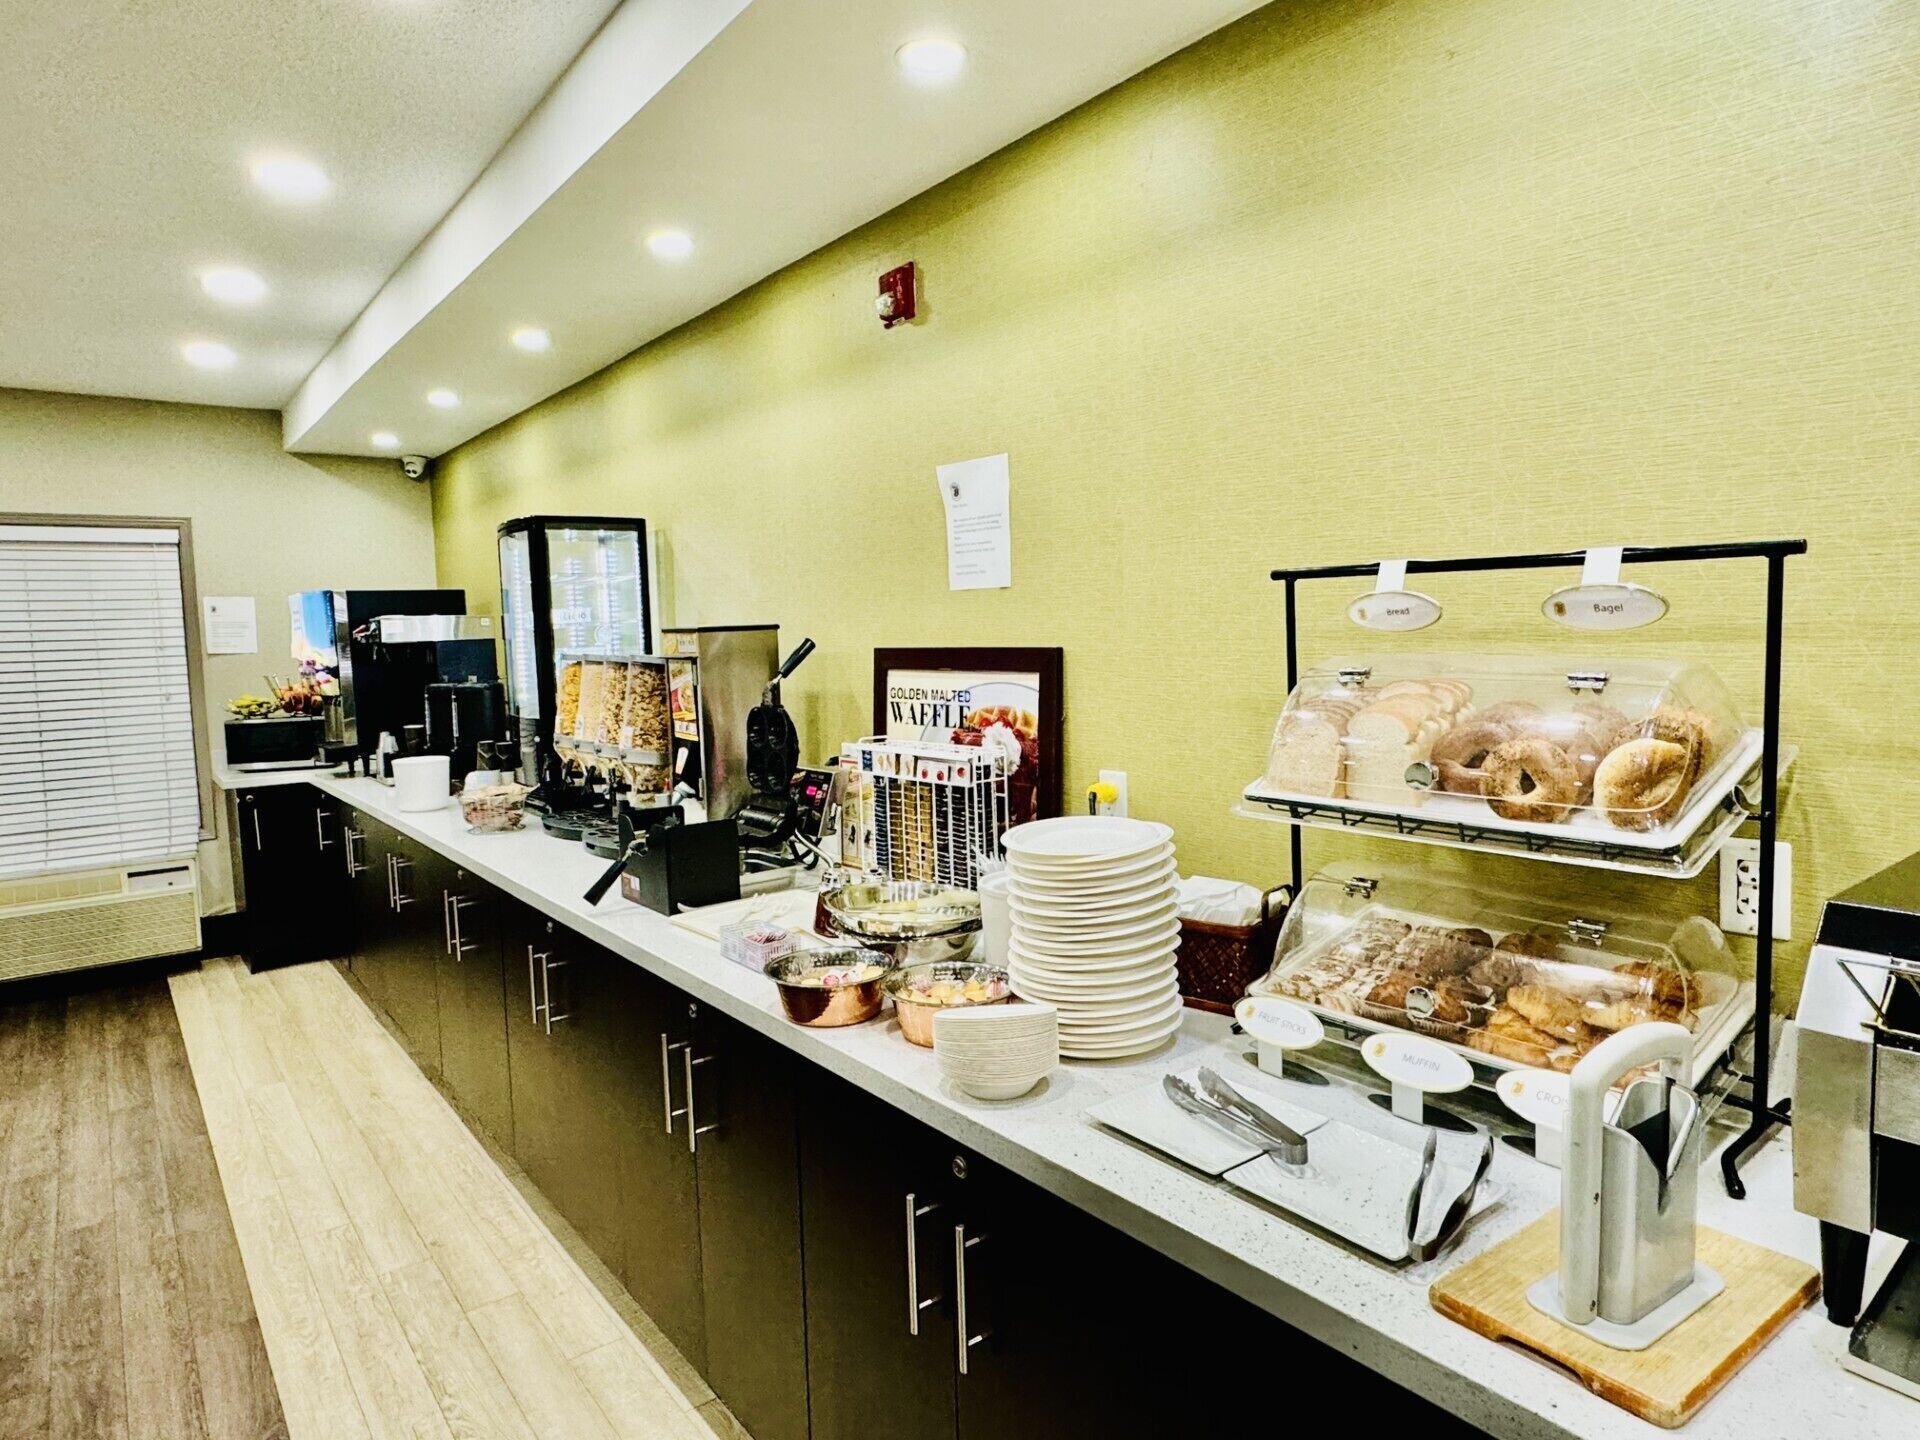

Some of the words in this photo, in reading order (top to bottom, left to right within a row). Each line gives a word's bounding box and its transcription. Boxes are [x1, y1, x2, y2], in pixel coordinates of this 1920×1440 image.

[1386, 607, 1410, 616] Bread
[1593, 603, 1624, 615] Bagel
[890, 687, 928, 701] GOLDEN
[930, 689, 971, 703] MALTED
[1402, 1053, 1441, 1073] MUFFIN
